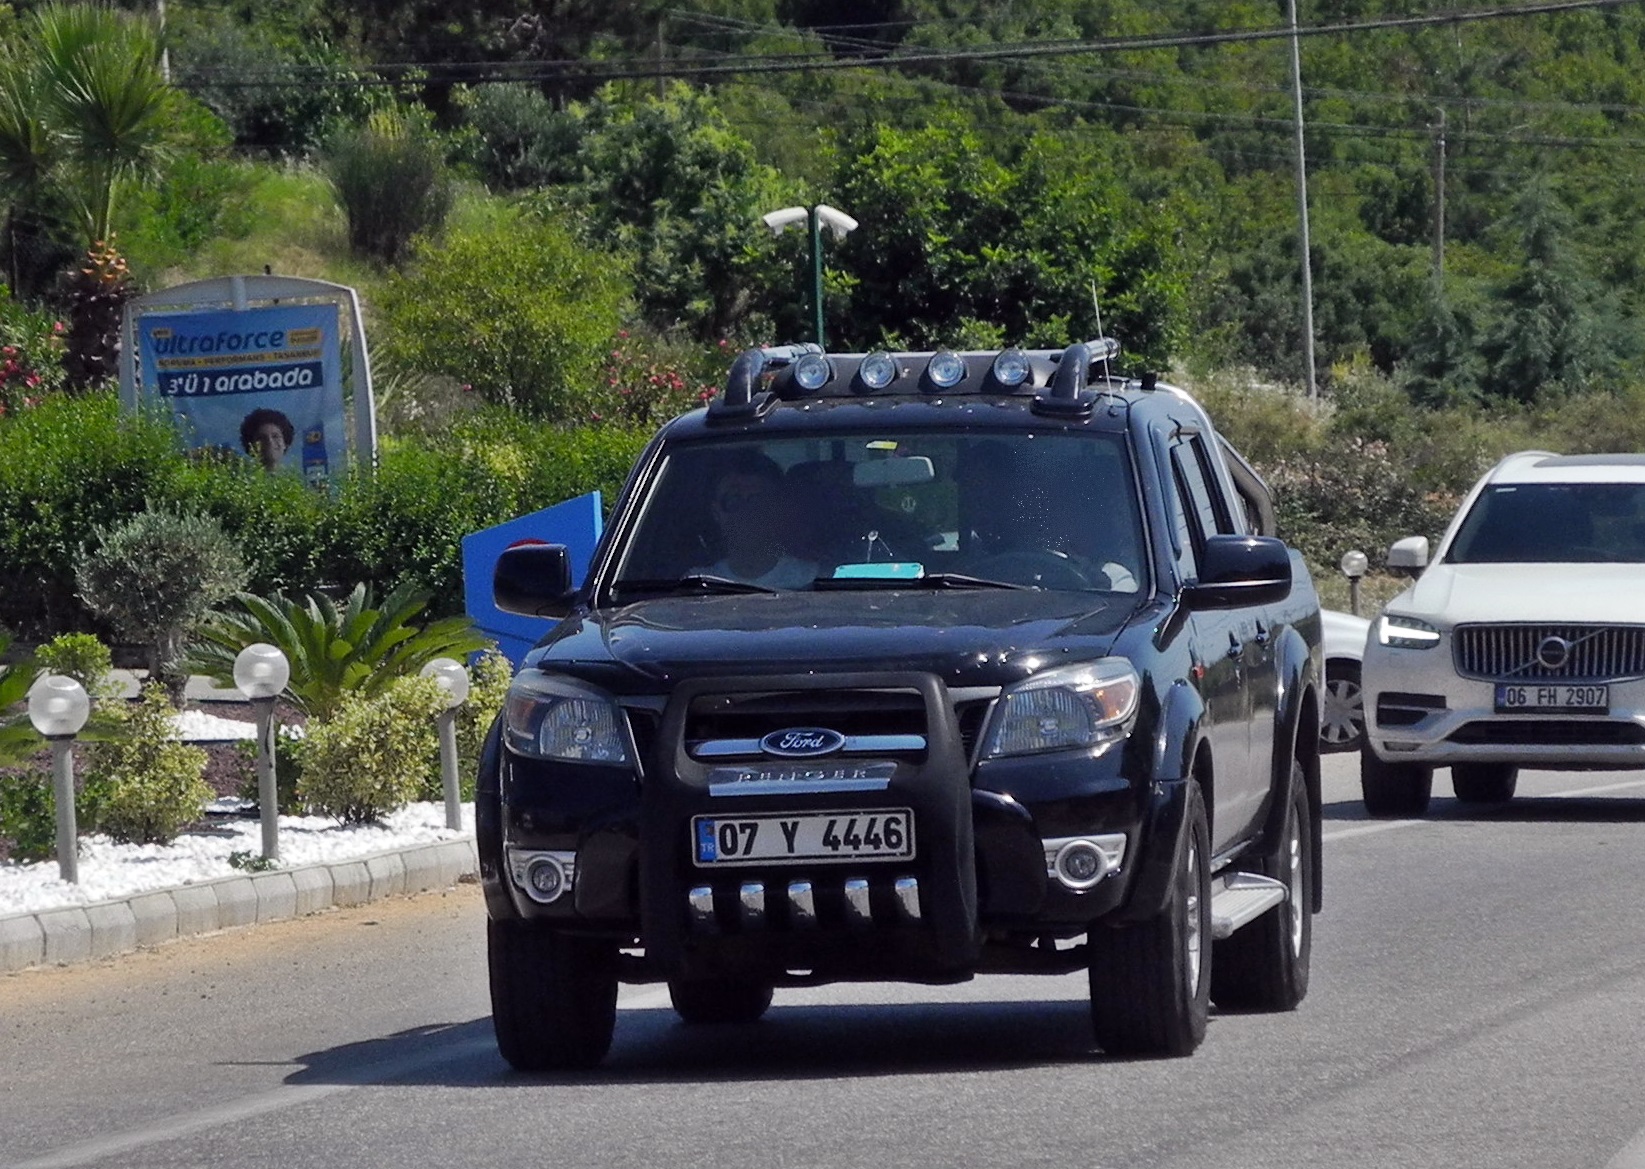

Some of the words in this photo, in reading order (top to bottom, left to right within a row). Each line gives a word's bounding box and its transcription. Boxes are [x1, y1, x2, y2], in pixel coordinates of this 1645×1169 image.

[155, 330, 284, 354] ultraforce
[215, 367, 313, 392] arabada
[1507, 689, 1526, 705] 06
[1537, 689, 1557, 705] FH
[1565, 688, 1605, 705] 2907
[780, 732, 824, 749] Ford
[718, 822, 759, 856] 07
[780, 820, 800, 854] Y
[822, 816, 904, 851] 4446
